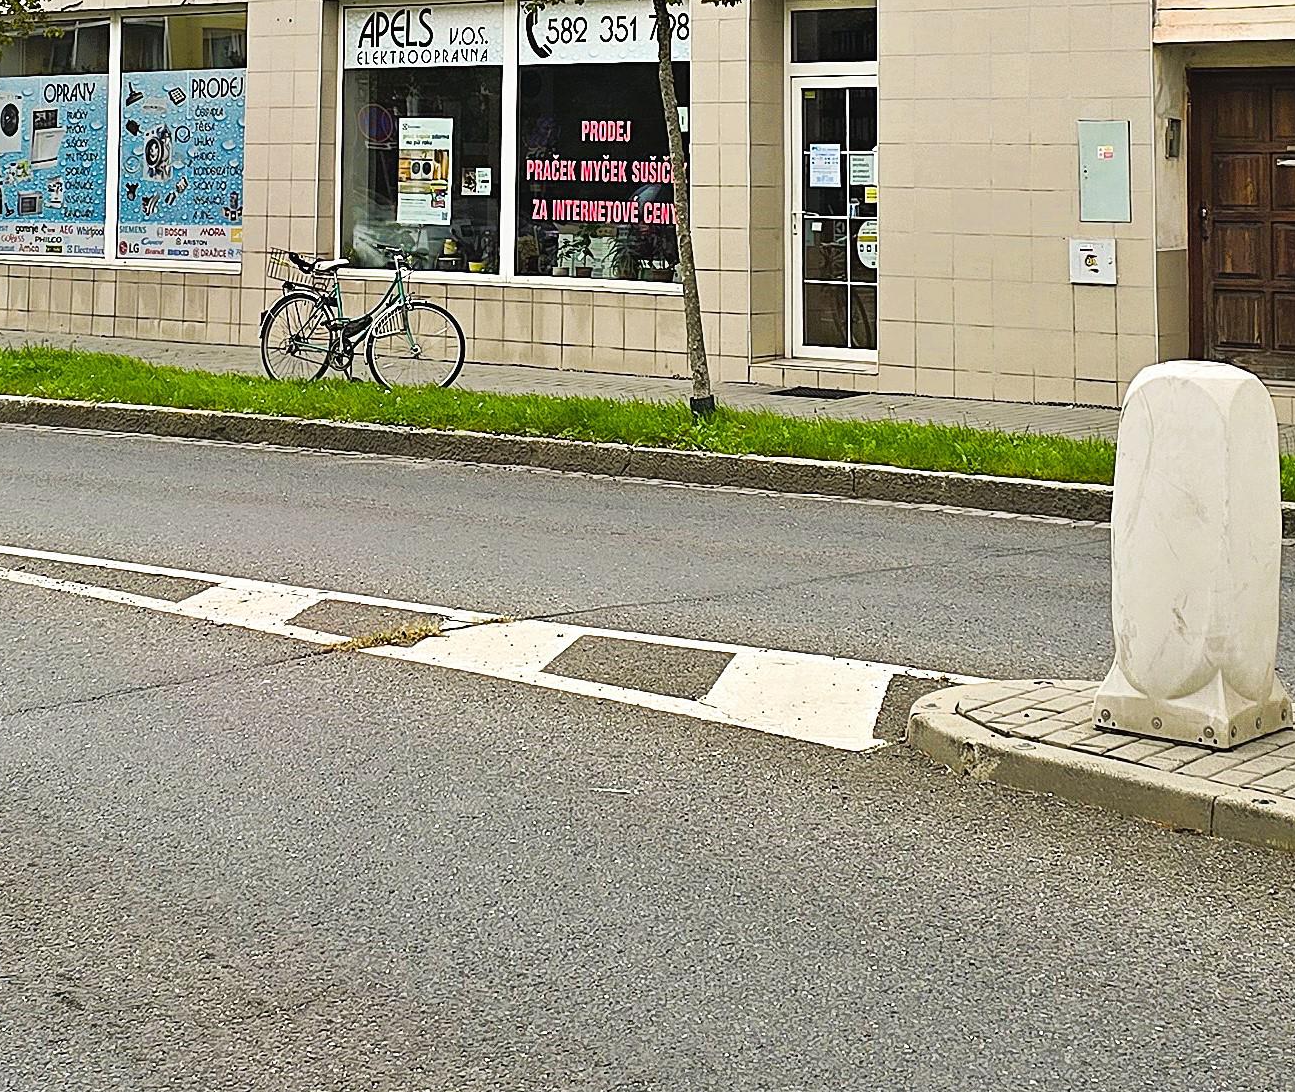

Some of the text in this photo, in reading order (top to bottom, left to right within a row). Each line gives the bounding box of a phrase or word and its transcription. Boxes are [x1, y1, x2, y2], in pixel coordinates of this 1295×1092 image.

[357, 7, 434, 49] APELS
[545, 16, 588, 44] 582
[599, 15, 637, 42] 351
[357, 48, 489, 66] ELEKTROOPRAVNA
[43, 82, 96, 103] OPRAVY
[191, 76, 244, 99] PRODEJ
[581, 120, 631, 143] PRODEJ
[526, 154, 576, 181] PRAČEK
[580, 154, 628, 182] MYČEK
[531, 196, 677, 225] ZA INTERNETOVÉ CENY
[60, 225, 74, 234] AEG
[119, 226, 226, 237] SIEMENS BOSCH MORA
[19, 242, 40, 252] Amica
[129, 243, 139, 253] LG
[200, 247, 227, 258] DRAŽICE
